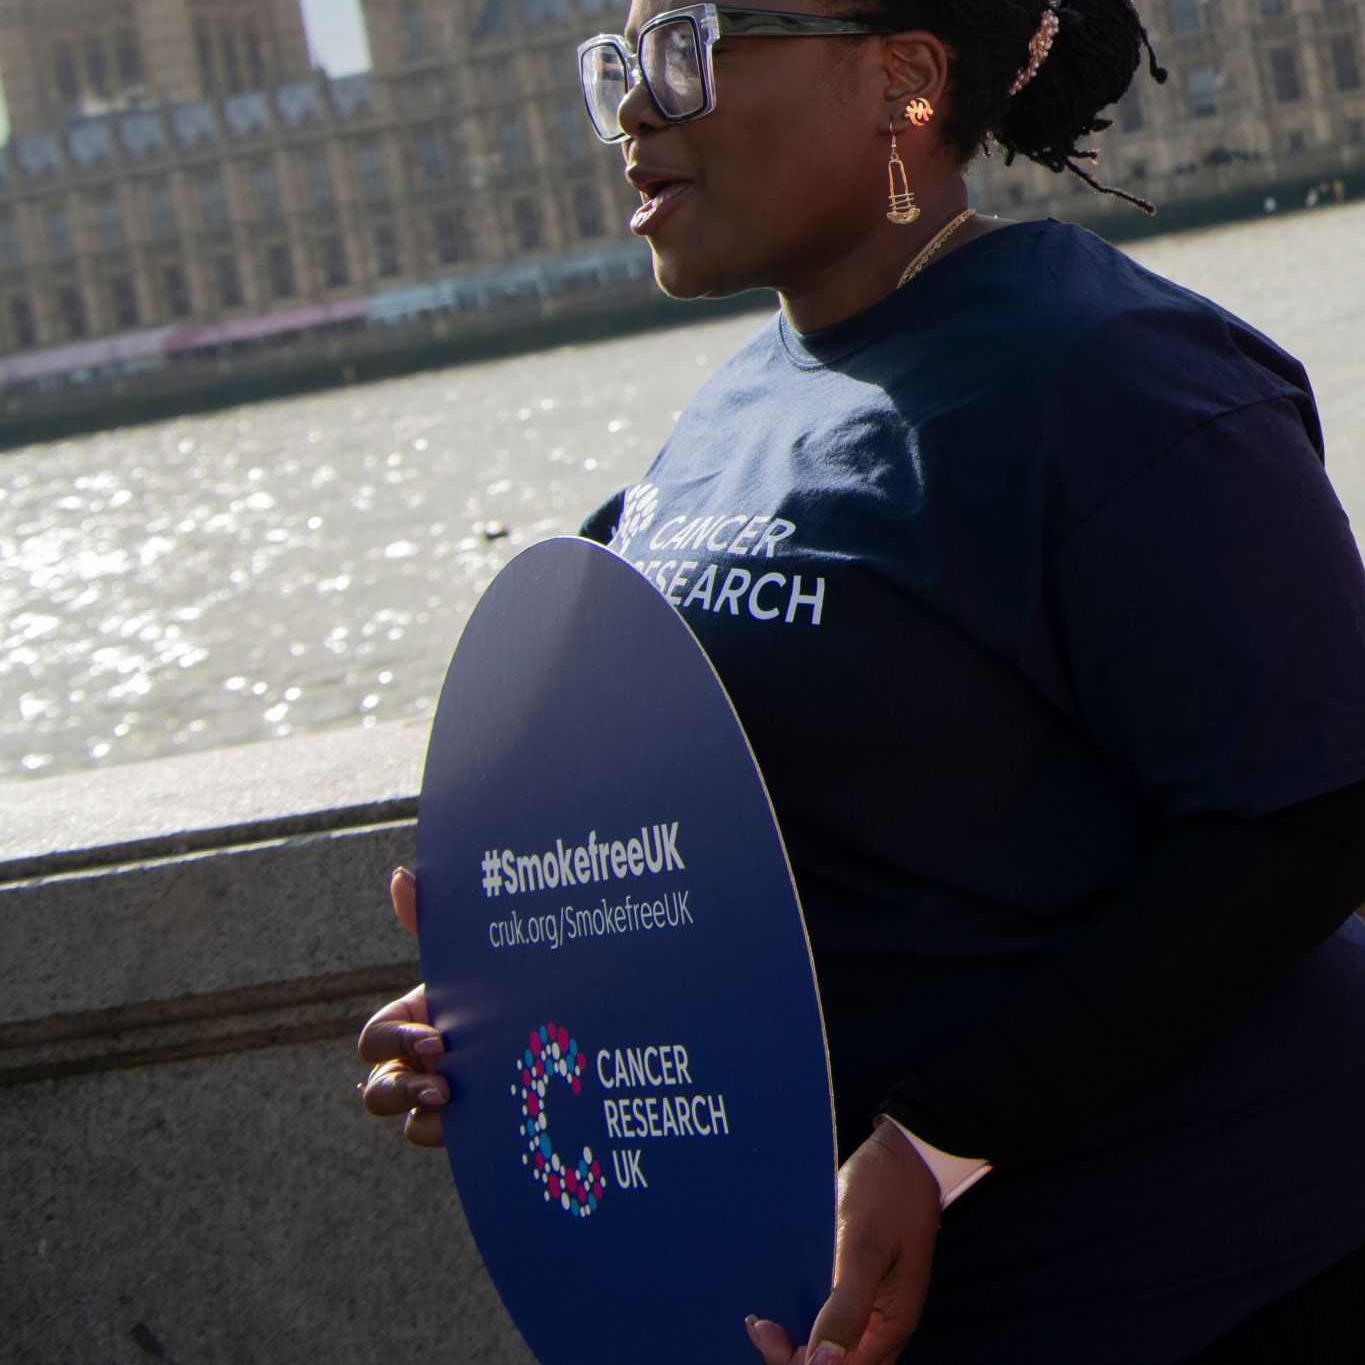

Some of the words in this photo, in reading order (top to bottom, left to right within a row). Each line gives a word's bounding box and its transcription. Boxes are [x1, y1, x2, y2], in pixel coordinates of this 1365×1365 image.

[649, 514, 796, 558] CANCER
[634, 560, 825, 625] SEARCH
[481, 821, 686, 898] #SmokefreeUK
[489, 890, 694, 950] cruk.org/SmokefreeUK
[596, 1044, 693, 1089] CANCER
[603, 1094, 730, 1139] RESEARCH
[612, 1149, 649, 1189] UK
